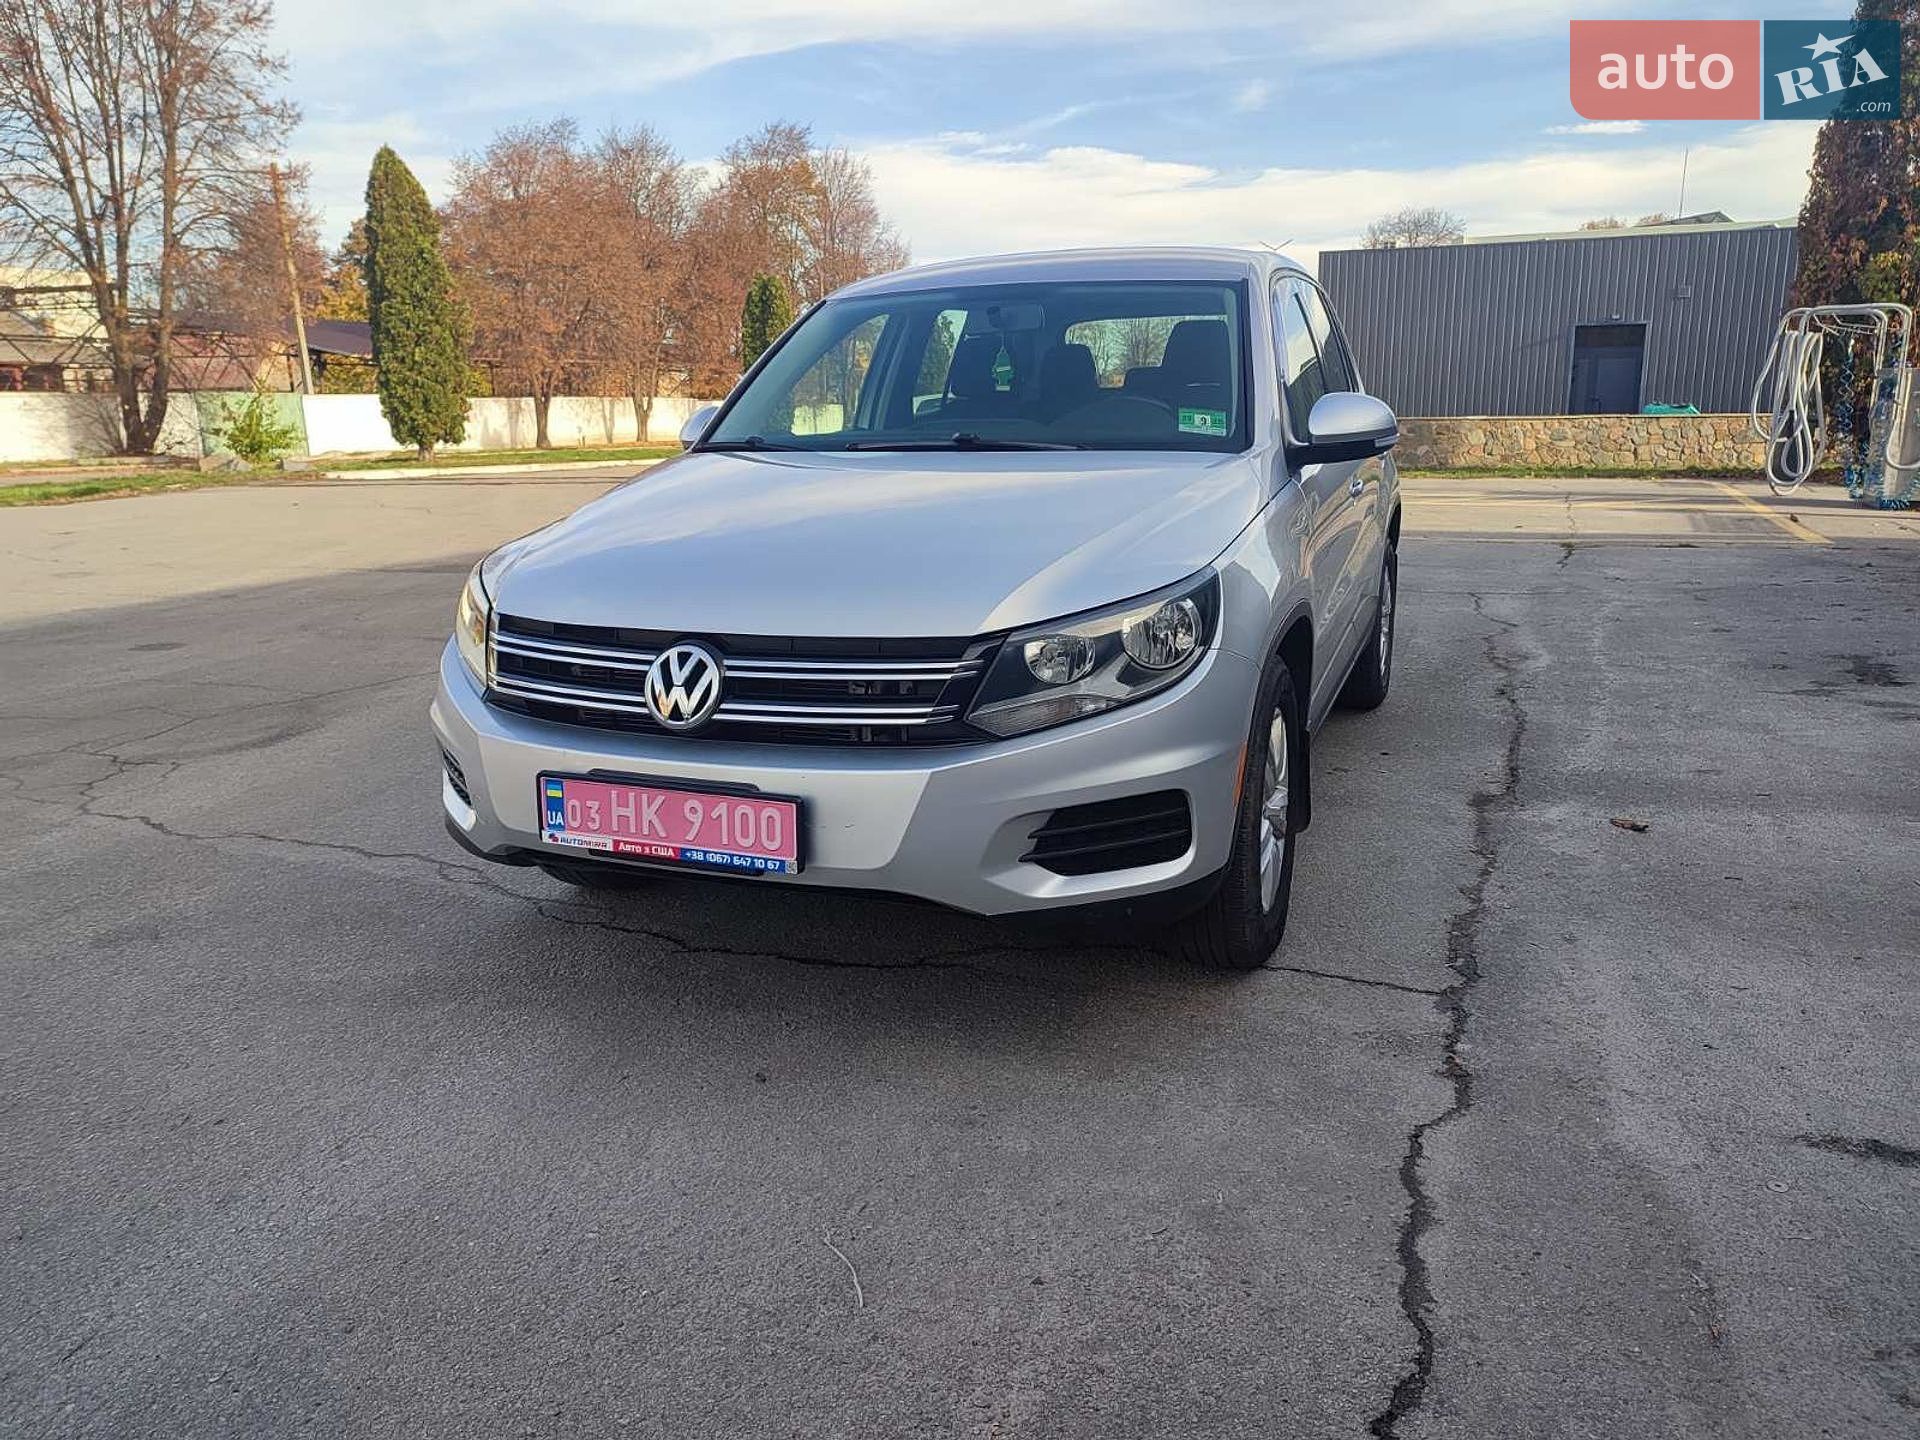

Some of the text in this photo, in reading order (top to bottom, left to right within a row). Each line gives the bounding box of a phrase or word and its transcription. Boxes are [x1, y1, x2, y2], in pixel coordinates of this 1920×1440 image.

[547, 811, 565, 827] UA
[567, 790, 782, 851] 03 HK 9100
[619, 842, 642, 854] Авто
[652, 847, 675, 857] США
[686, 850, 704, 861] +38
[706, 852, 730, 865] (067)
[754, 859, 765, 869] 10
[767, 860, 780, 870] 67
